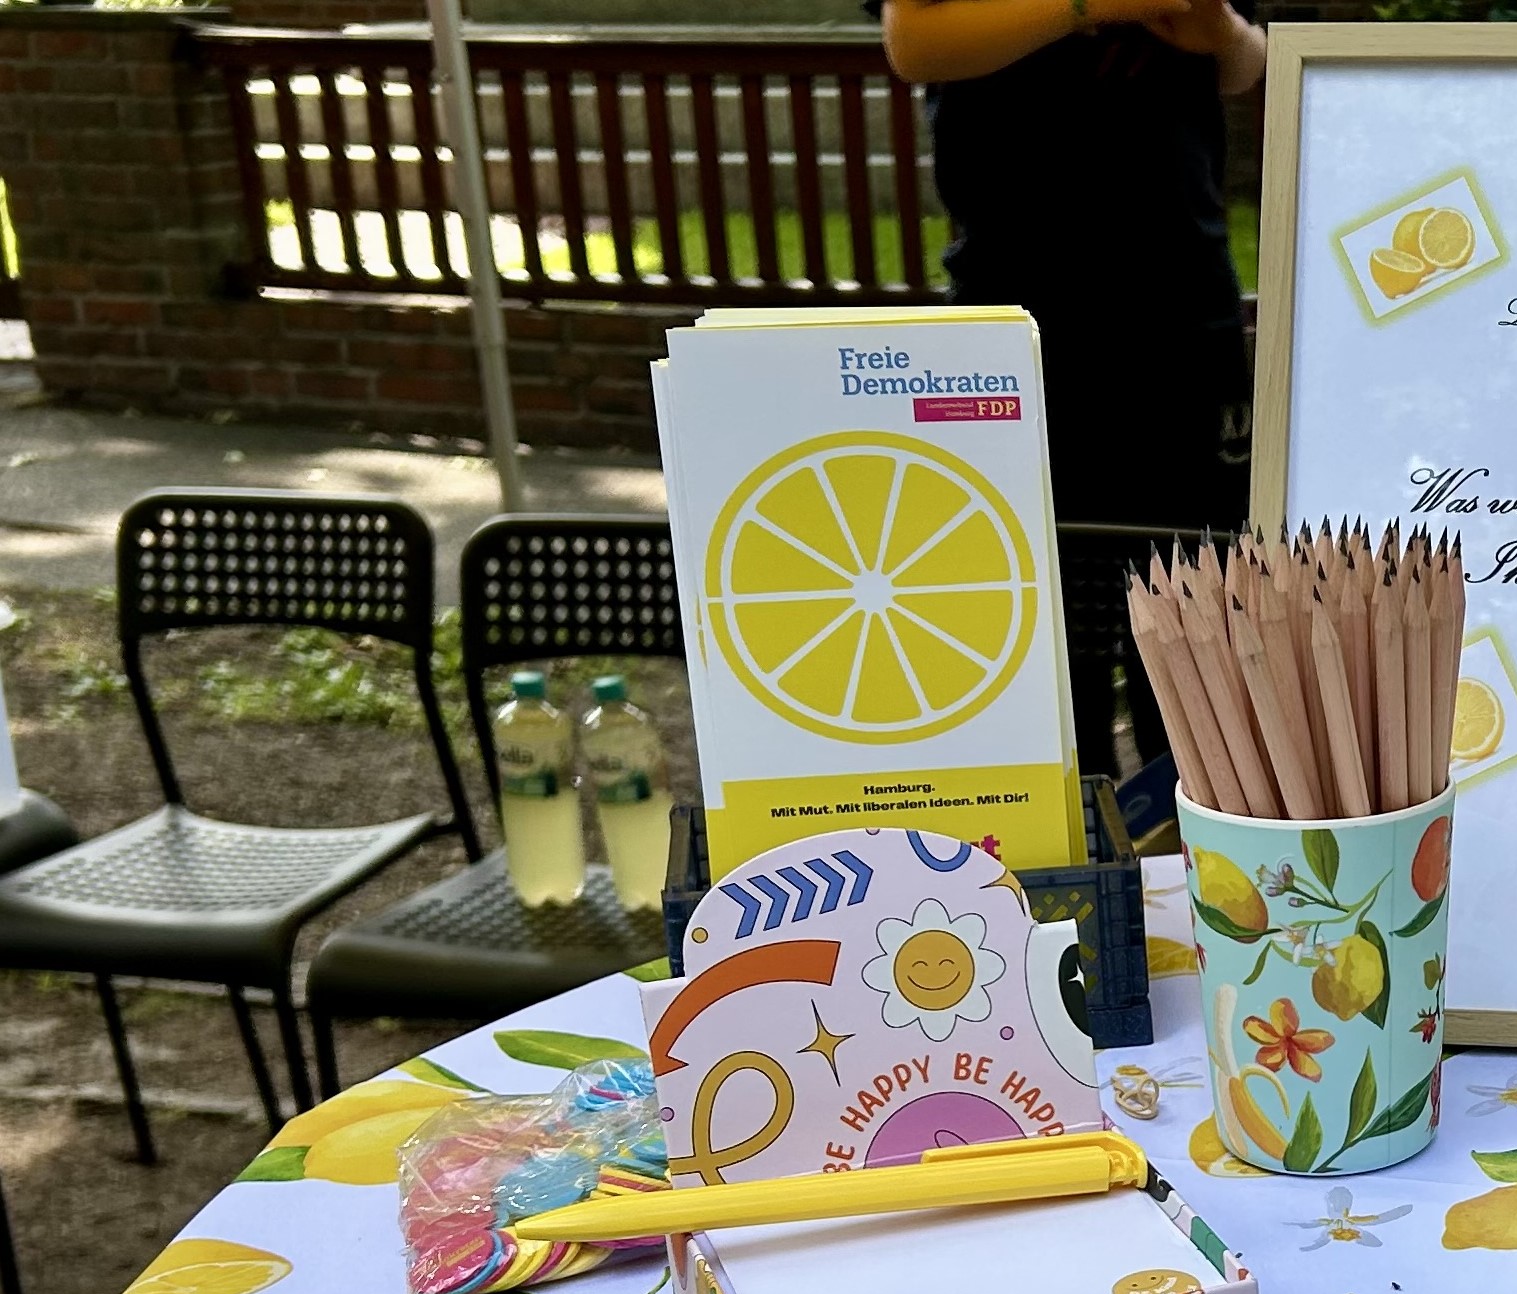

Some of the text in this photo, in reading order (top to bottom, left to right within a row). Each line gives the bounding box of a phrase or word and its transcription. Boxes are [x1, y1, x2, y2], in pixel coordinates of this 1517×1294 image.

[838, 346, 910, 370] Freie
[840, 370, 1020, 396] Demokraten
[976, 400, 1017, 417] FDP
[1410, 468, 1490, 514] Was
[863, 783, 936, 796] Hamburg.
[771, 807, 797, 818] Mit
[836, 803, 861, 814] Mit
[976, 794, 1002, 806] Mit
[840, 1054, 931, 1132] HAPPY
[952, 1052, 993, 1085] BE
[1000, 1071, 1065, 1137] HAPP
